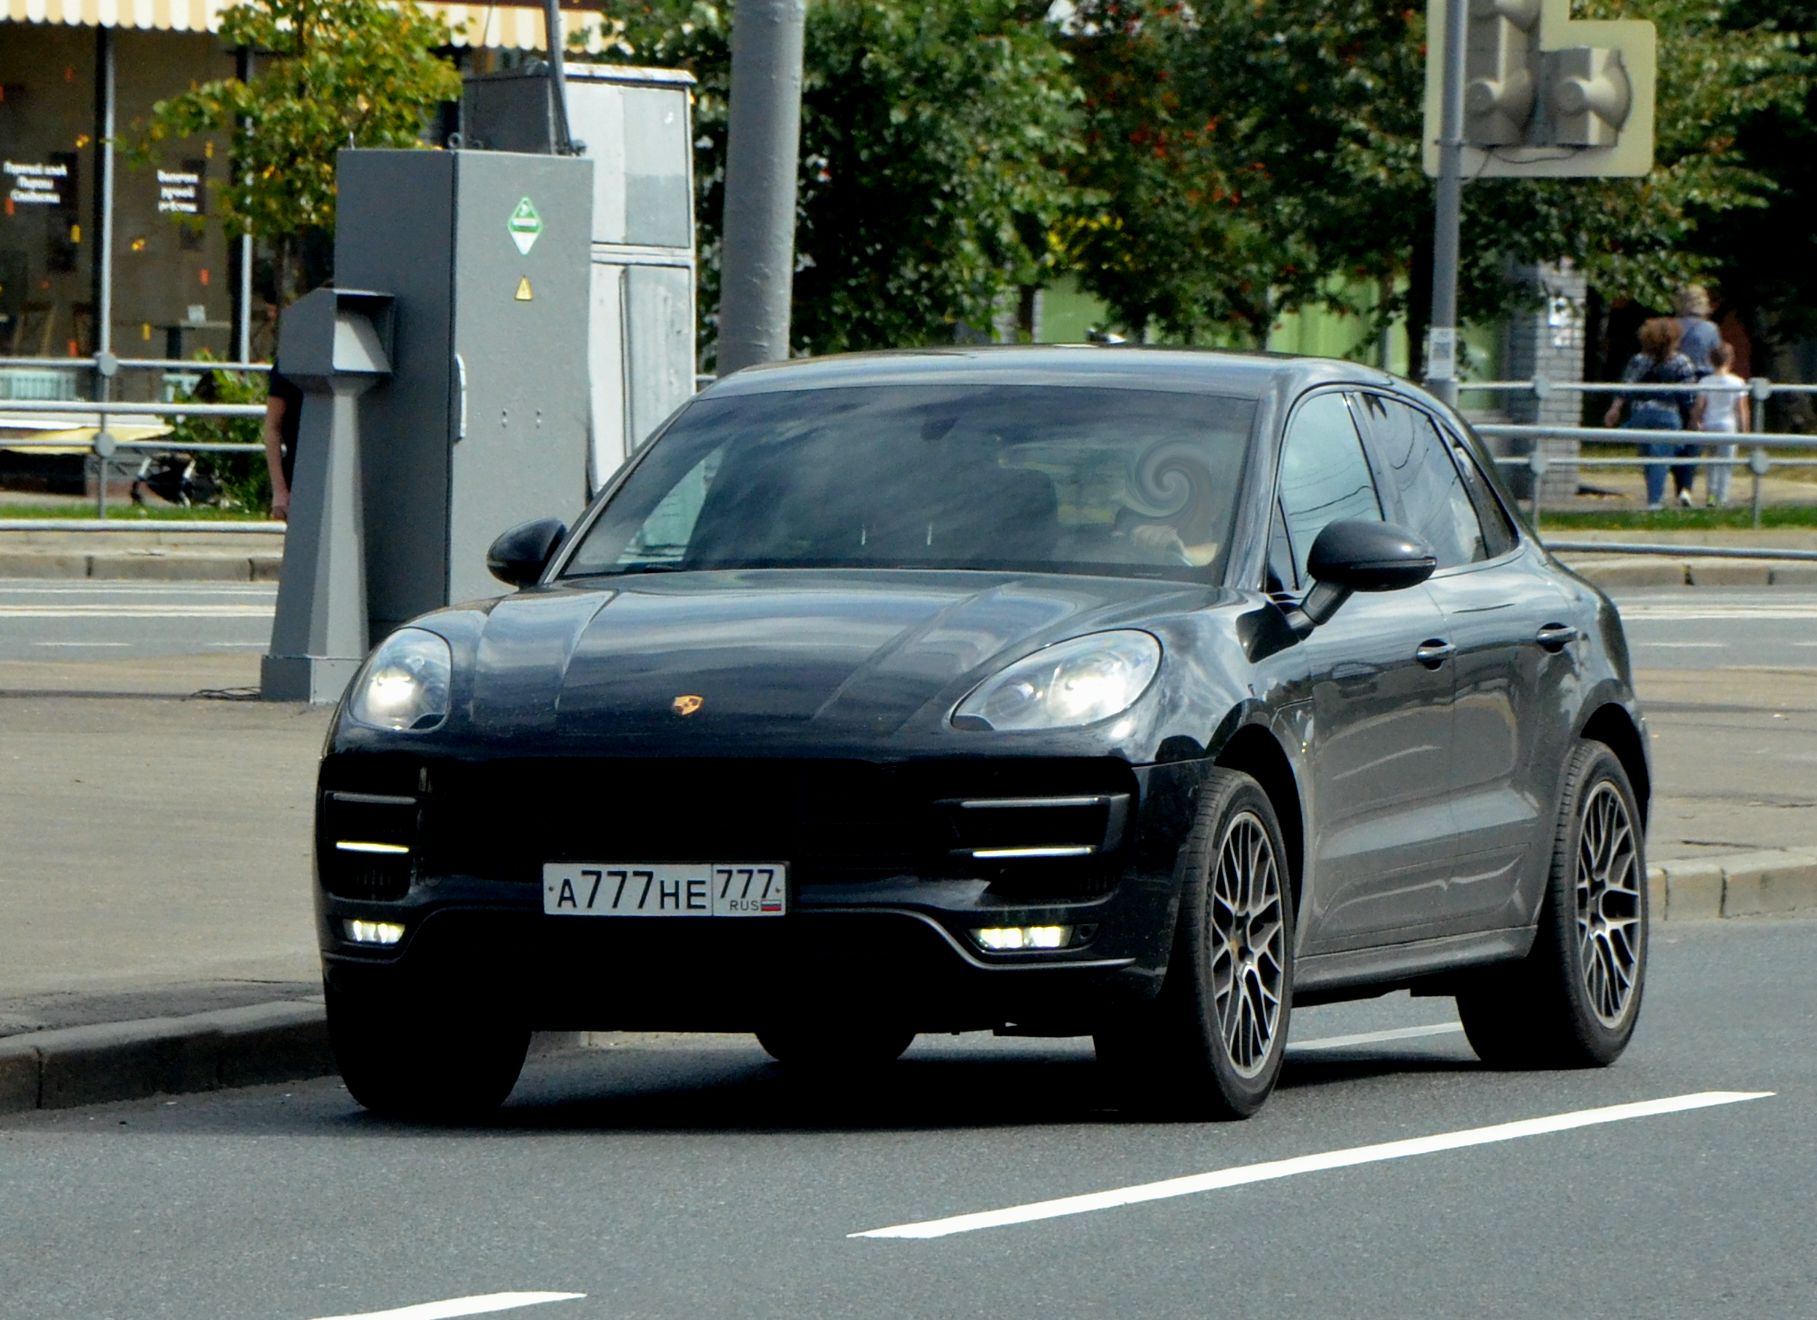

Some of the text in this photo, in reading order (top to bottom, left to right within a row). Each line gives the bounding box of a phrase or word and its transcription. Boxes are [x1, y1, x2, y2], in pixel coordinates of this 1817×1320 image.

[557, 868, 775, 910] A777HE 777
[729, 899, 759, 911] RUS
